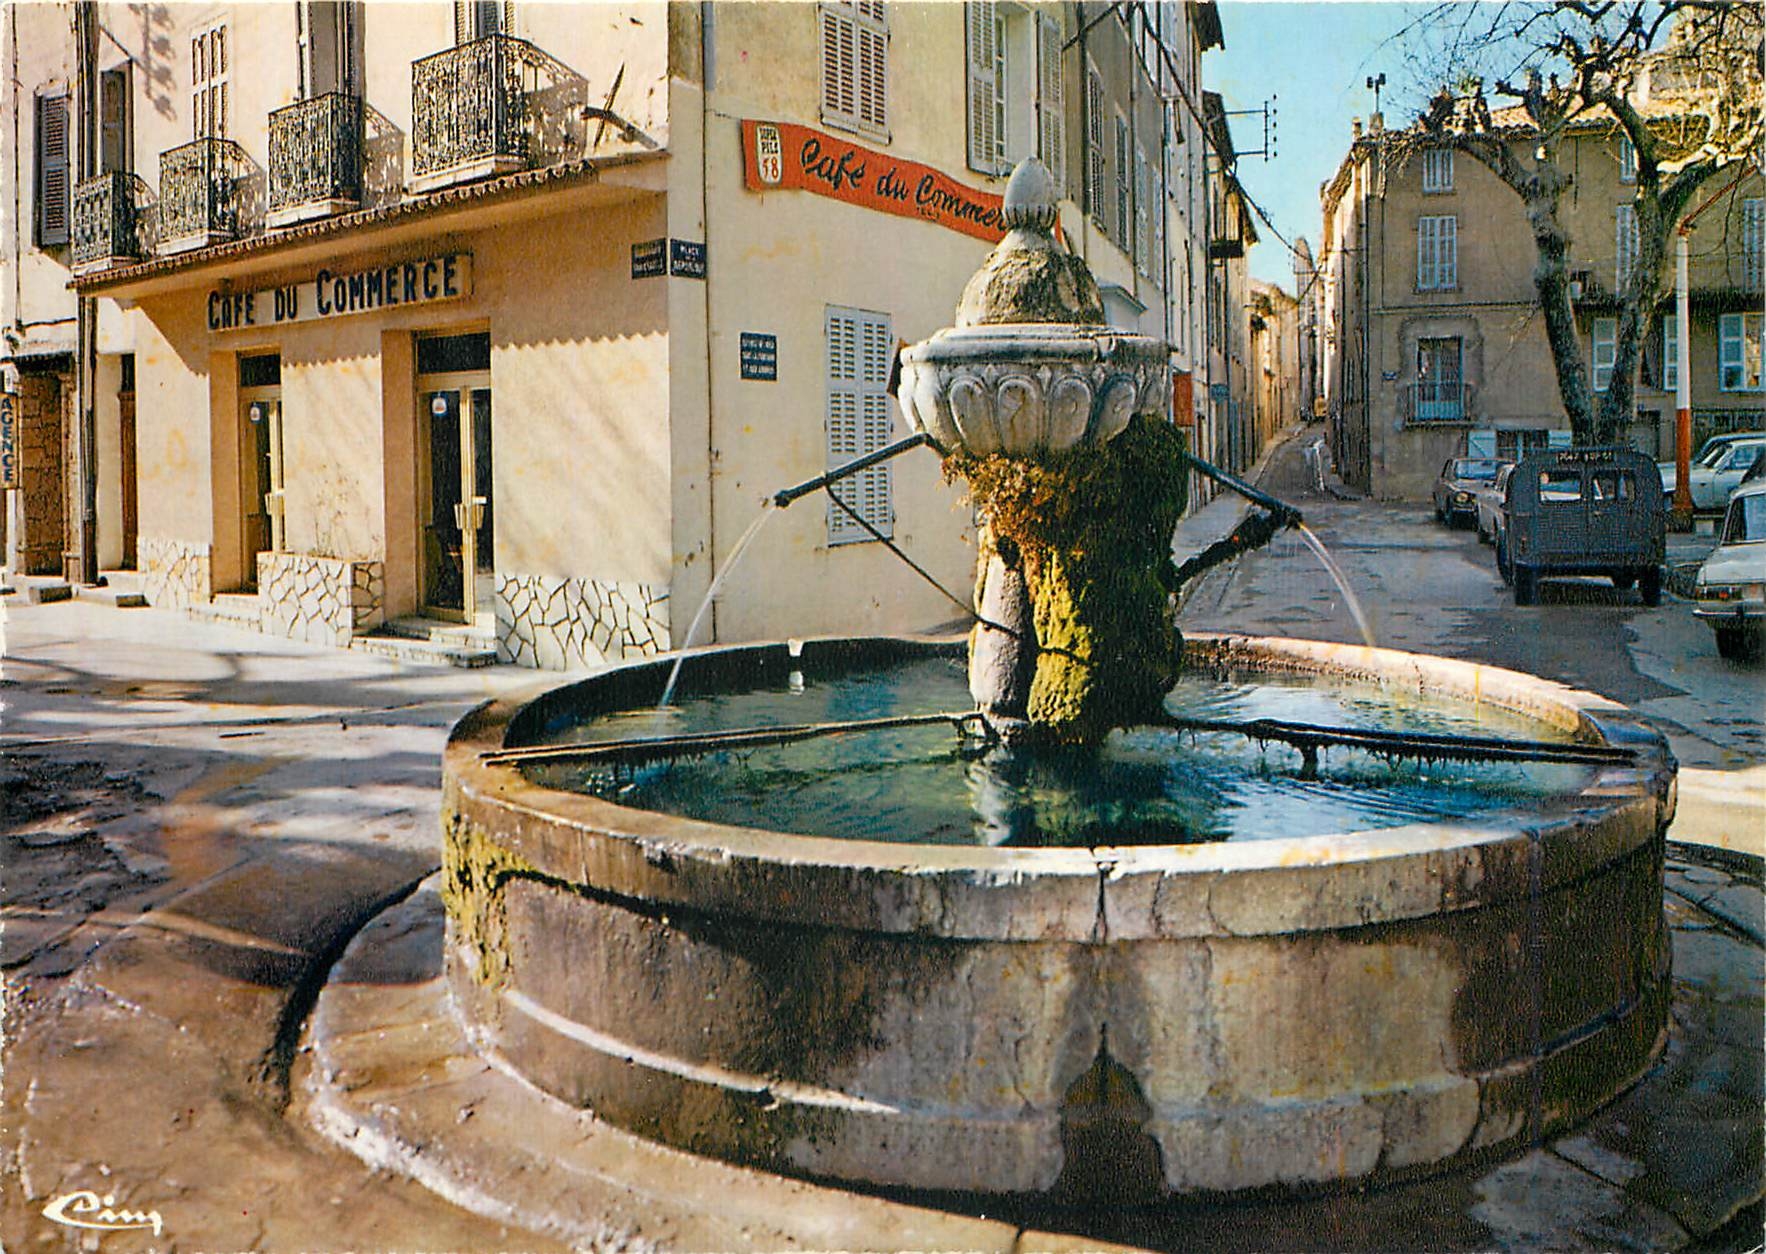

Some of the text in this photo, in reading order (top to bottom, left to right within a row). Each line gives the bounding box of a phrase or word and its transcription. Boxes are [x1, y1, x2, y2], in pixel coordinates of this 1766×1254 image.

[800, 137, 1008, 232] Café du Commer
[274, 285, 298, 322] DU
[316, 254, 459, 316] COMMERCE
[1, 397, 15, 483] AGENCE
